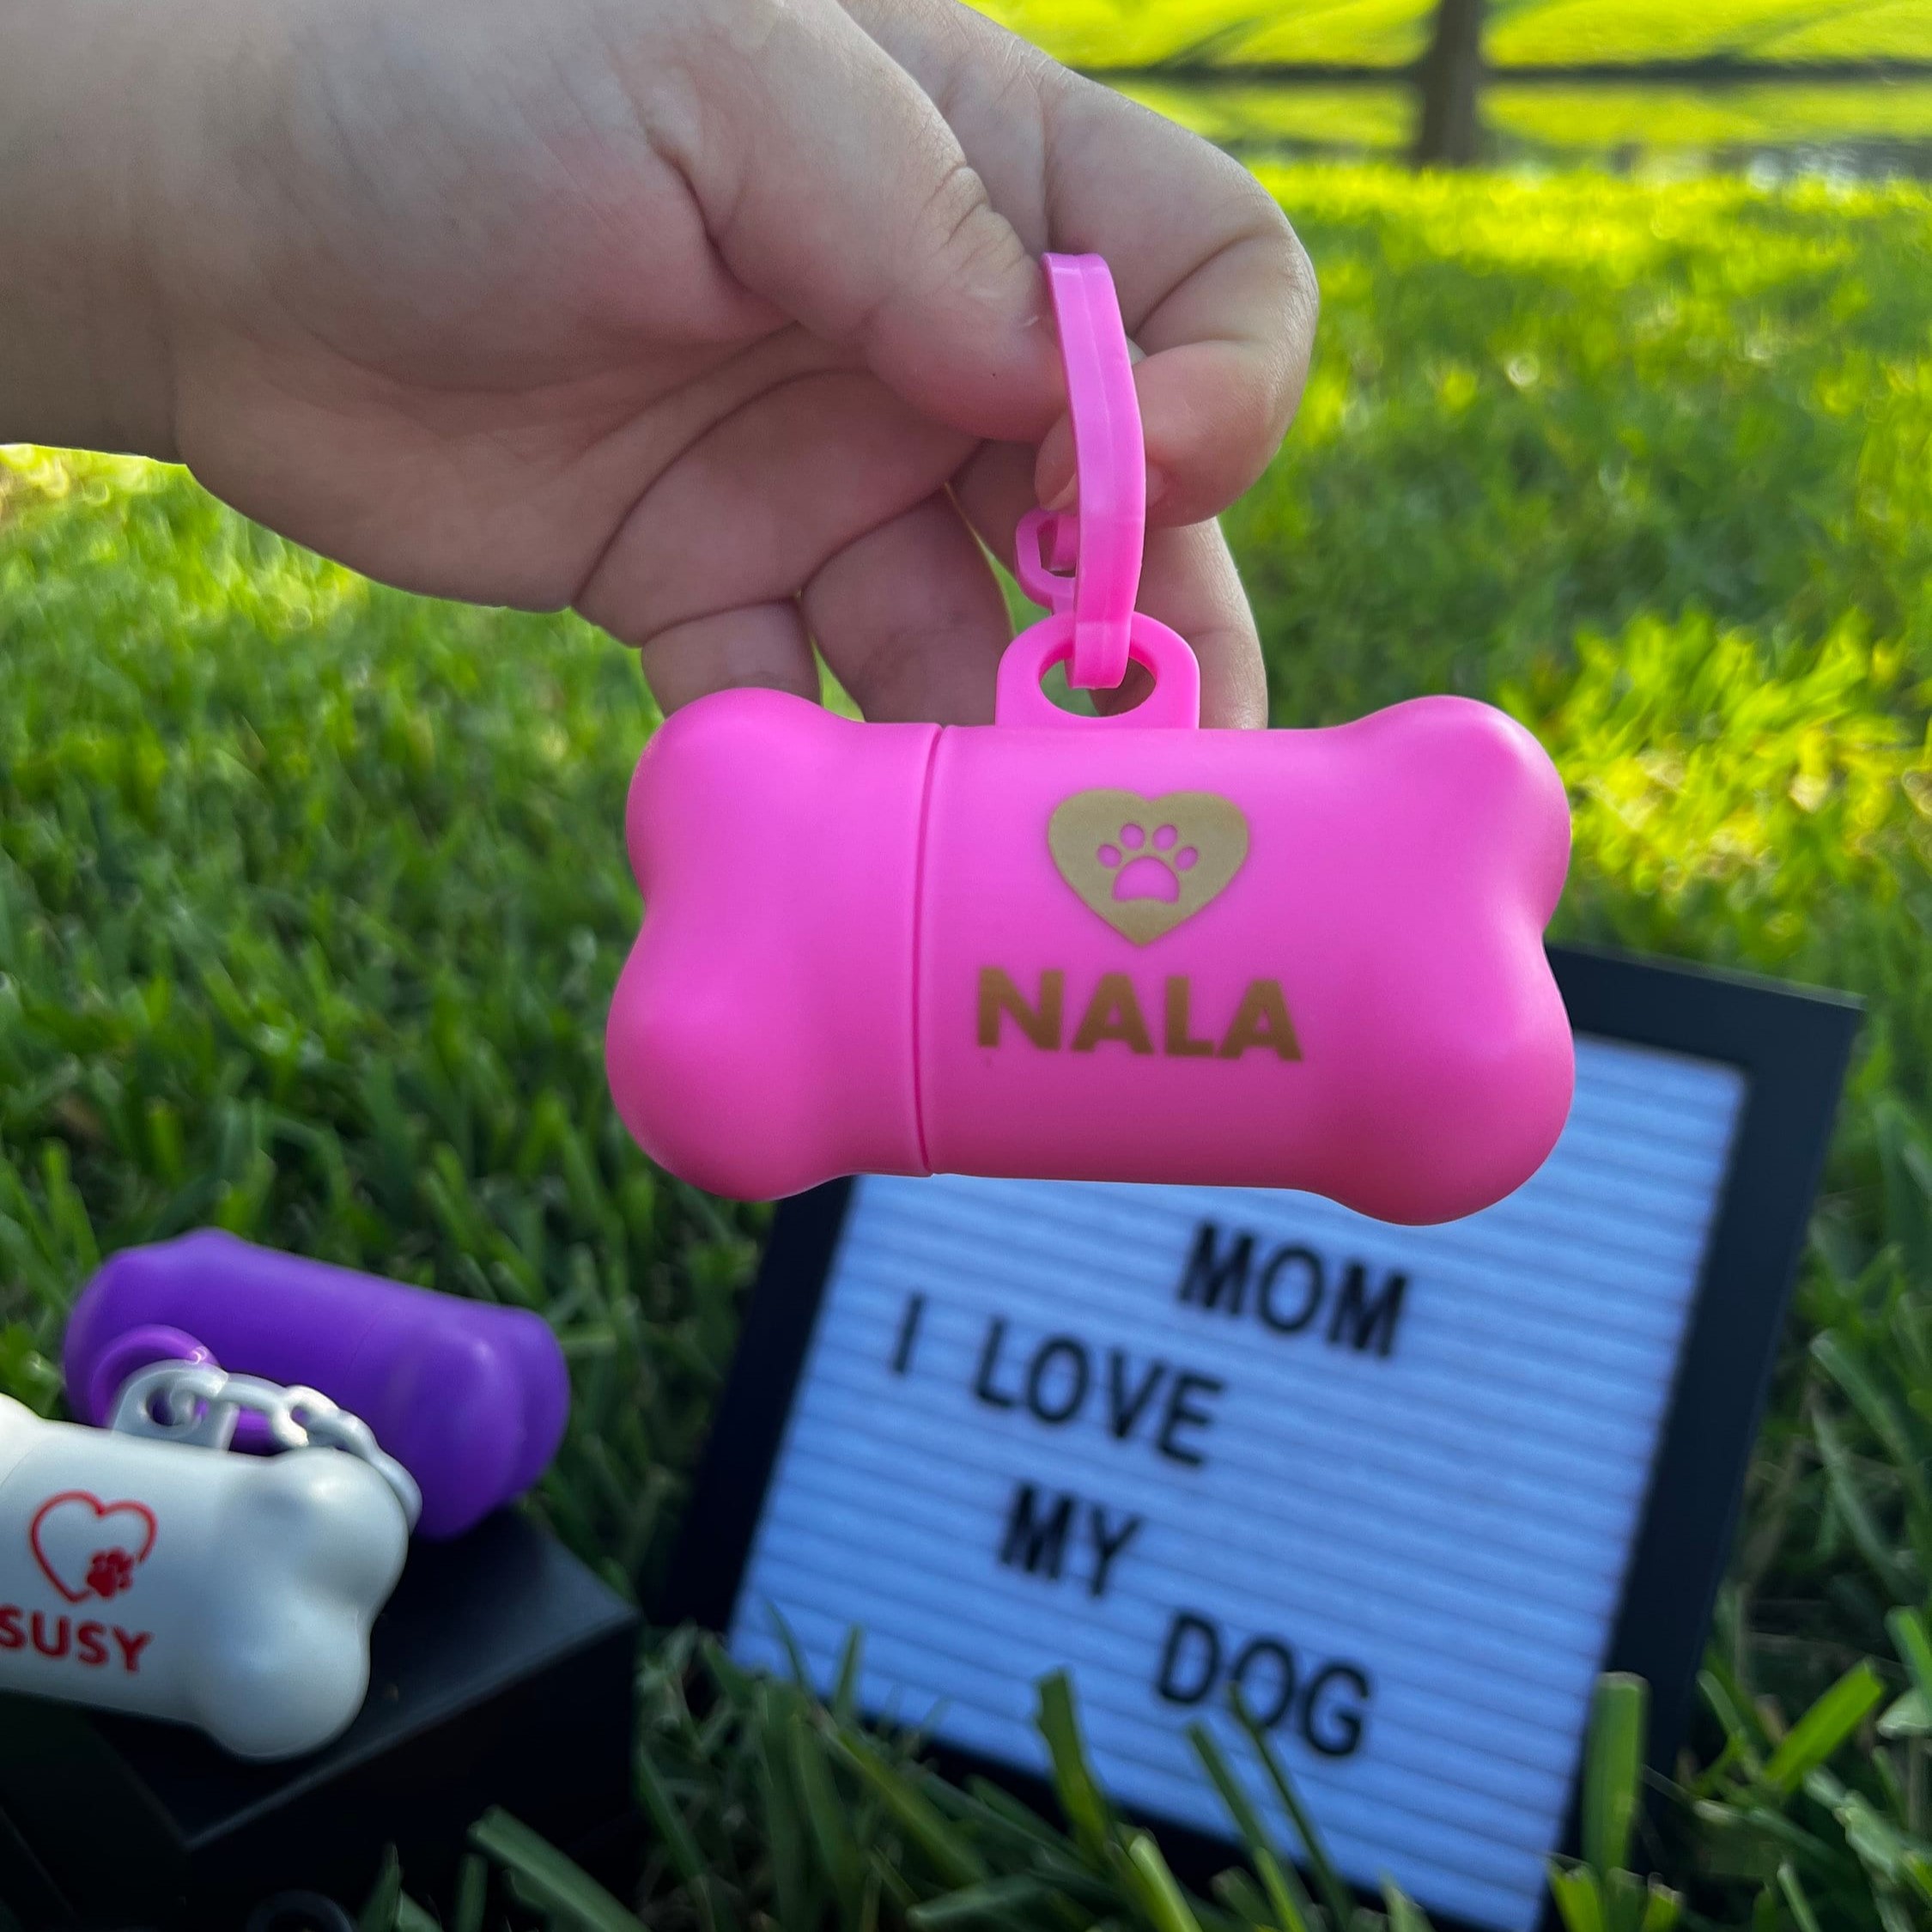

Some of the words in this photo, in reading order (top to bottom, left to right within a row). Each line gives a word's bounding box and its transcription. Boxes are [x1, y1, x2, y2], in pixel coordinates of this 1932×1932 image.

[977, 967, 1303, 1062] NALA
[1177, 1221, 1408, 1358] MOM
[892, 1294, 926, 1376] I
[974, 1315, 1224, 1467] LOVE
[997, 1482, 1141, 1598] MY
[0, 1605, 153, 1674] SUSY
[1157, 1613, 1371, 1758] DOG
